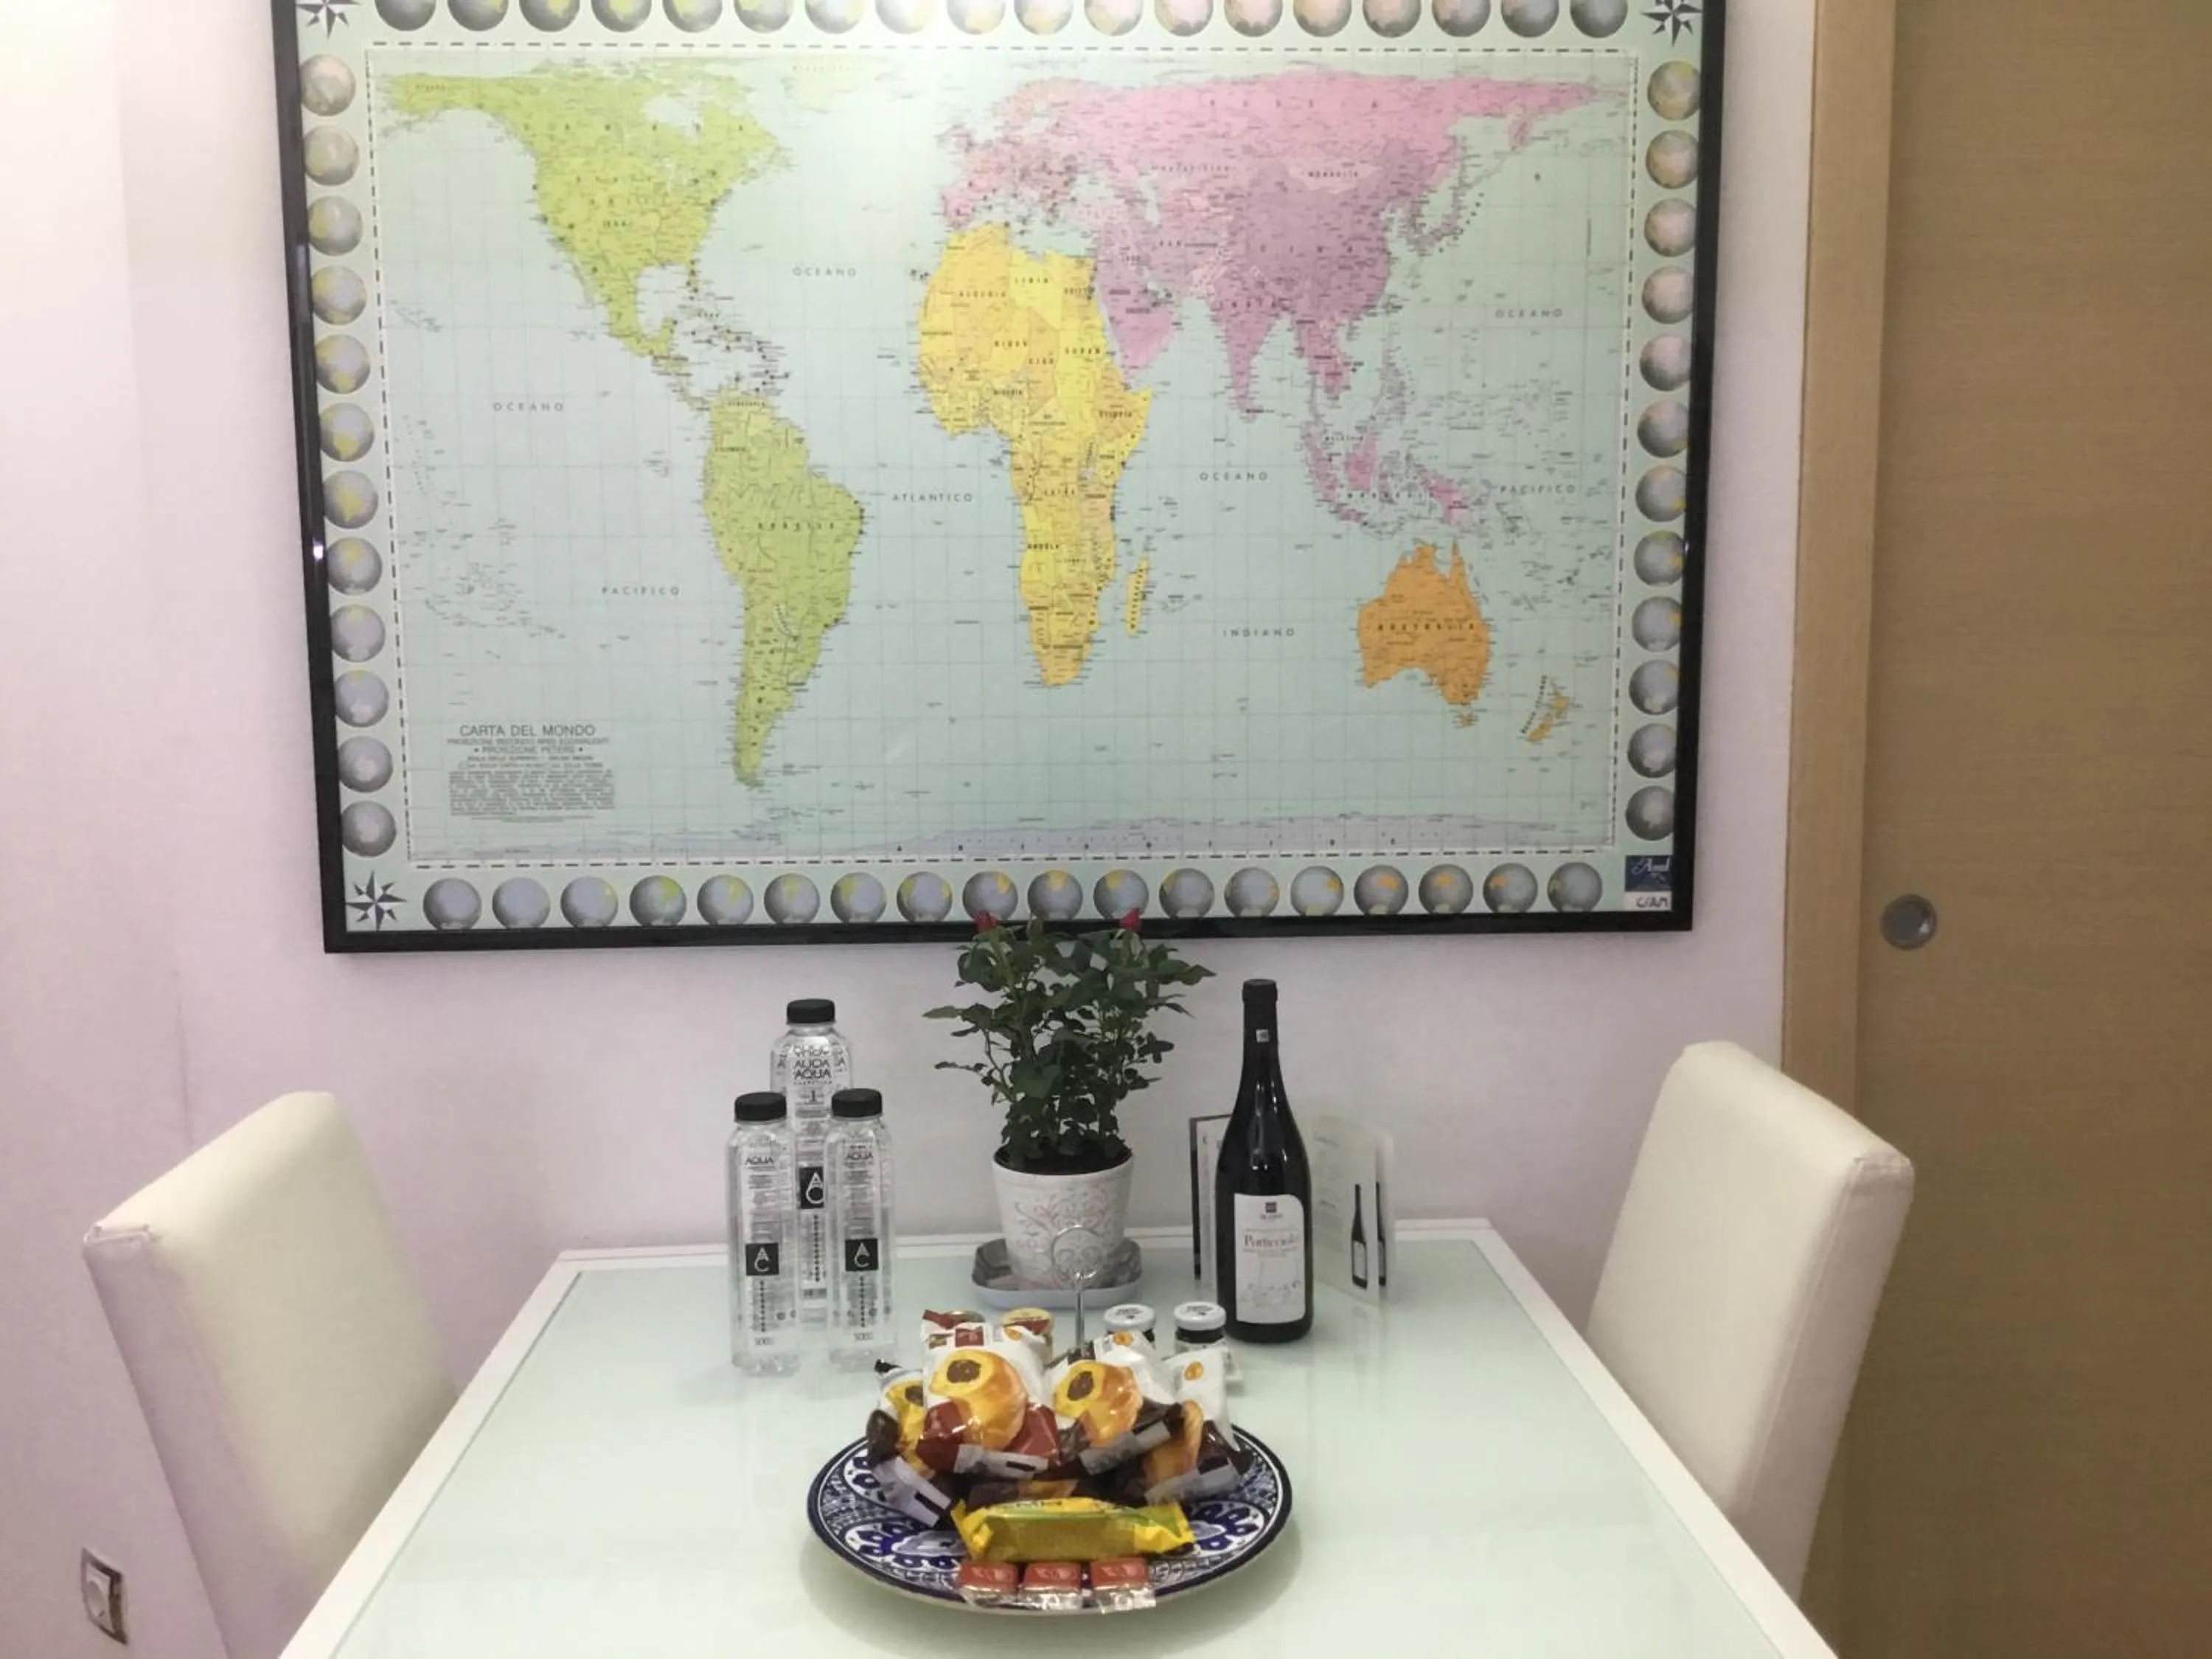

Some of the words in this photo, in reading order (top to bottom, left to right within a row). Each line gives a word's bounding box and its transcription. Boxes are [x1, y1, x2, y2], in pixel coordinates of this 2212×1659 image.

[892, 492, 973, 503] ATLANTICO
[1222, 627, 1295, 638] INDIANO
[459, 724, 505, 737] CARTA
[510, 725, 537, 737] DEL
[542, 724, 596, 737] MONDO
[794, 1068, 832, 1080] AQUA
